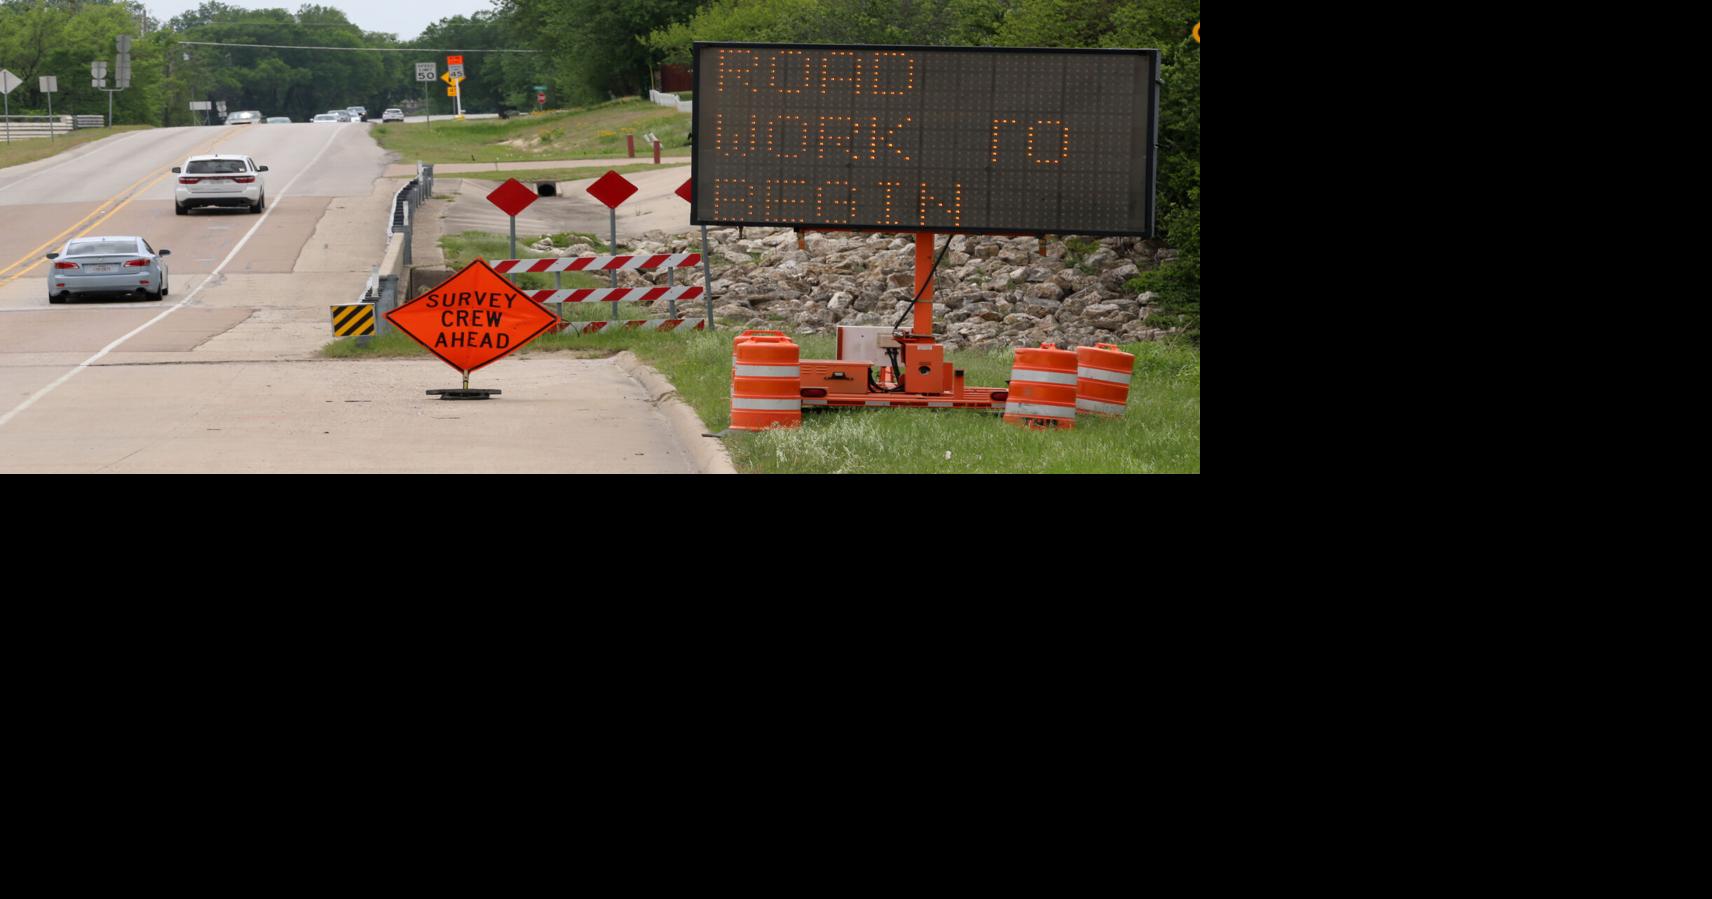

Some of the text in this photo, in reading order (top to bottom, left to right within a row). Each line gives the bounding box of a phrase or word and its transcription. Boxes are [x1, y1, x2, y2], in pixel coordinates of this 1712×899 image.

[417, 72, 435, 80] 50
[719, 49, 914, 95] ROAD
[716, 113, 912, 161] WORK
[714, 178, 961, 227] BEGIN
[426, 291, 517, 308] SURVEY
[441, 310, 502, 327] CREW
[434, 332, 510, 349] AHEAD
